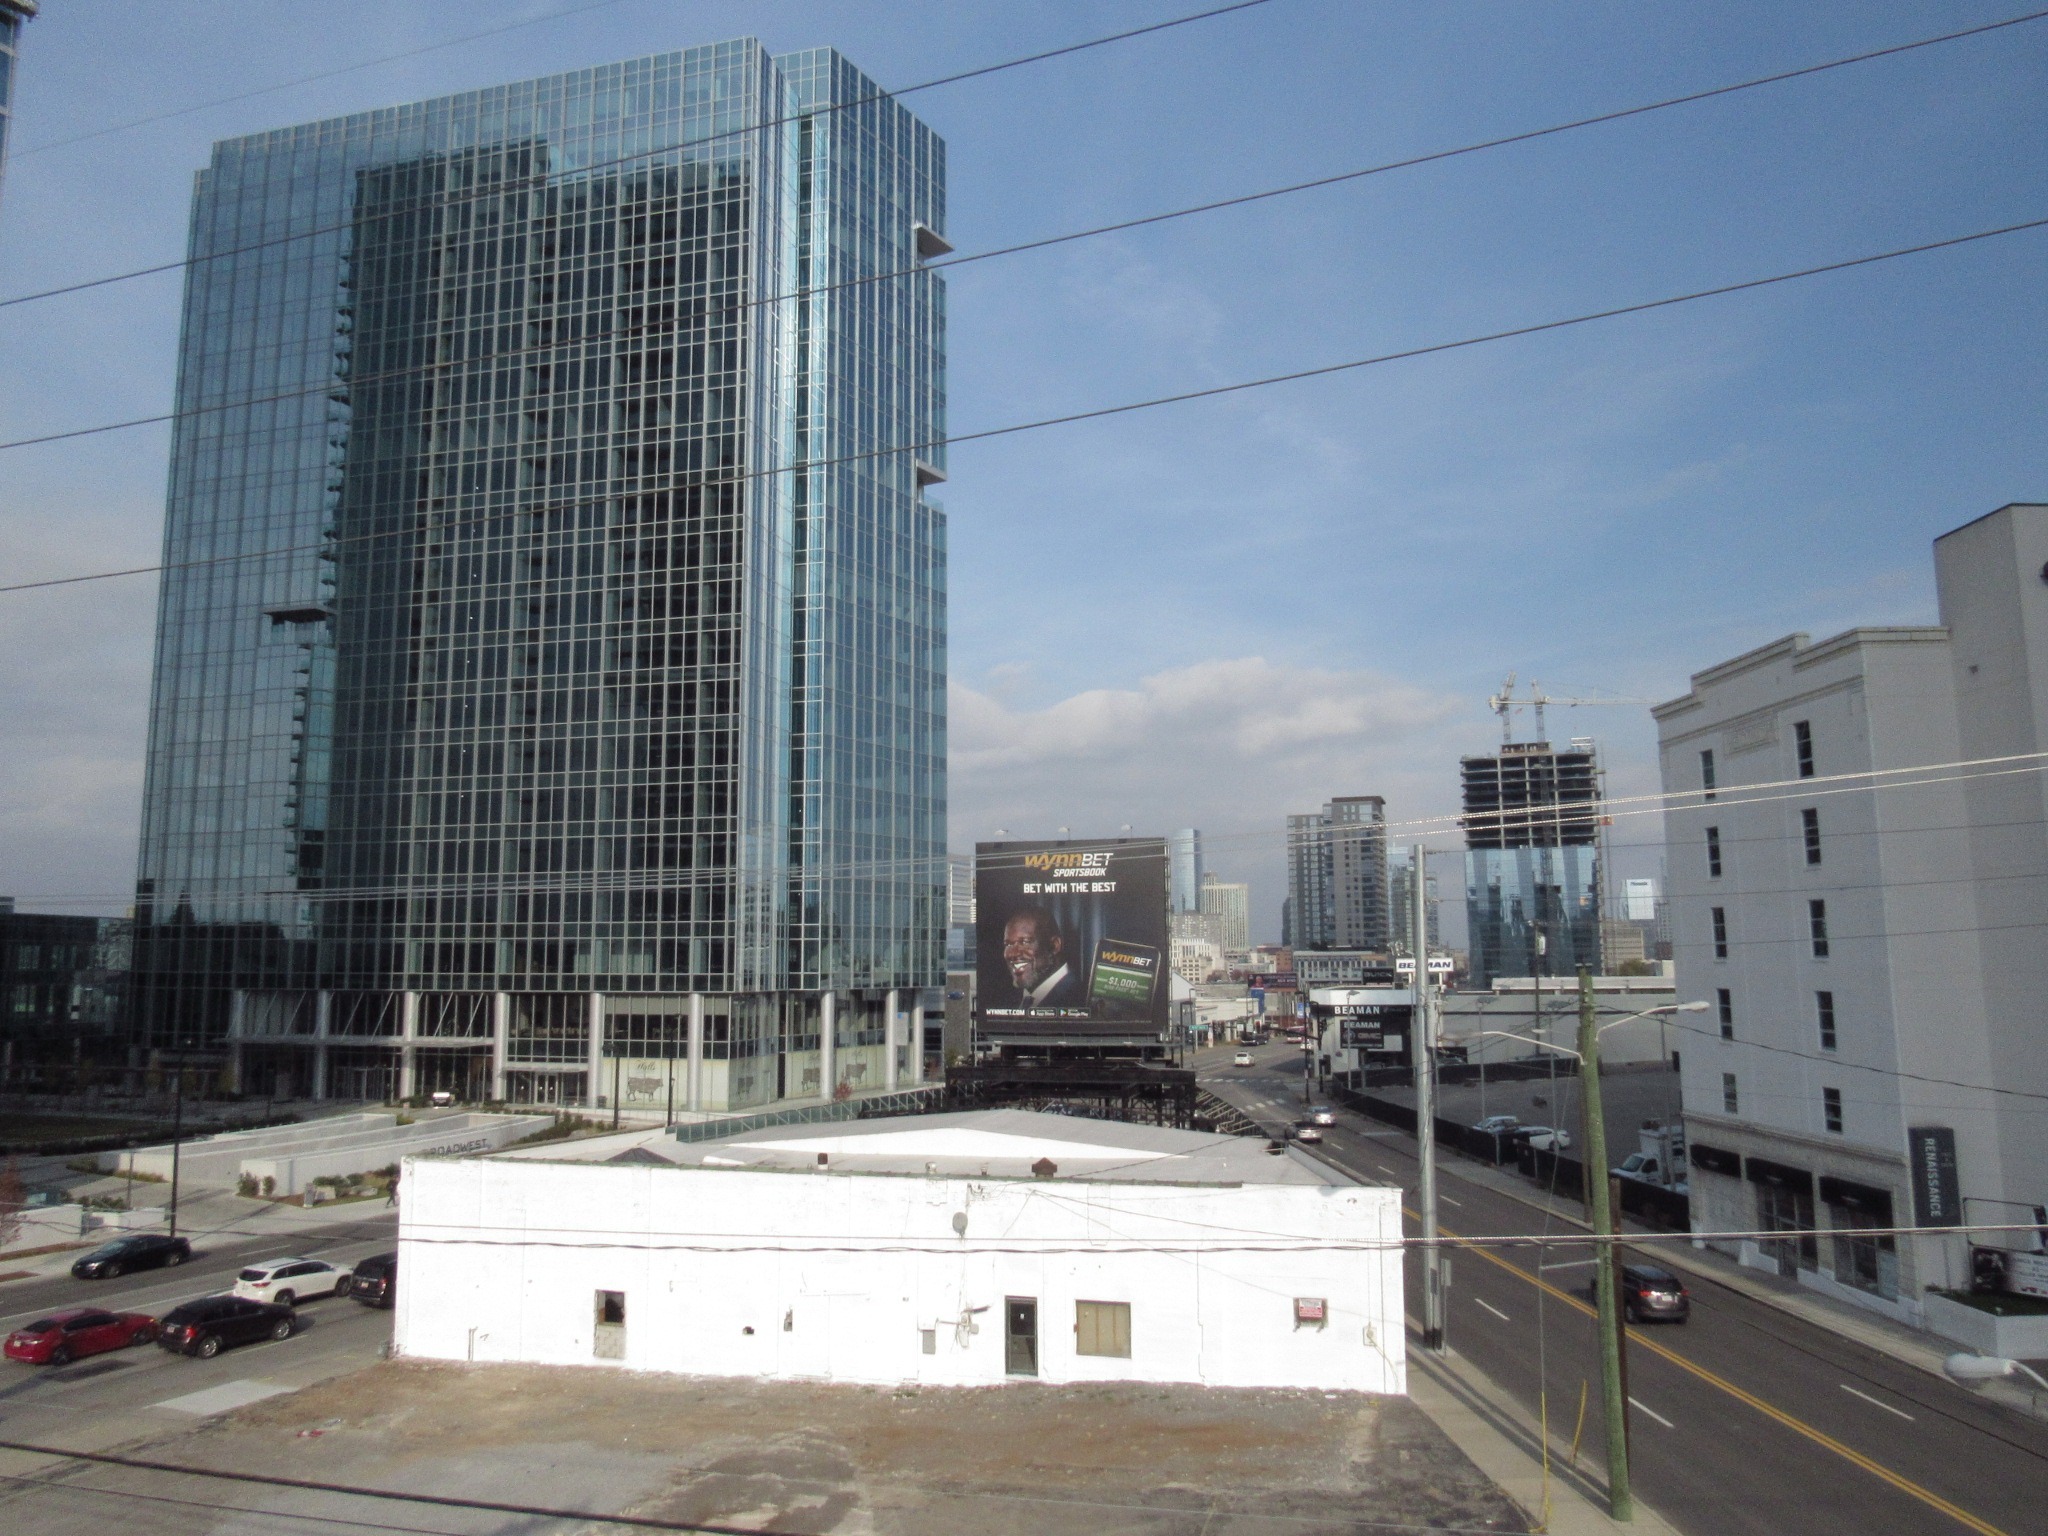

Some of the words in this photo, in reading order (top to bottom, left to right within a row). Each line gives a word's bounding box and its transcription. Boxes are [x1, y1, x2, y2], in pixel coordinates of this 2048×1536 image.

[1053, 867, 1107, 877] SPORTSBOOK
[1023, 883, 1041, 893] BET
[1044, 883, 1068, 893] WITH
[1070, 882, 1089, 893] THE
[1091, 881, 1116, 893] BEST
[1334, 1005, 1380, 1015] BEAMAN
[422, 1138, 487, 1155] ROADWEST
[1924, 1138, 1942, 1217] RENAISSANCE
